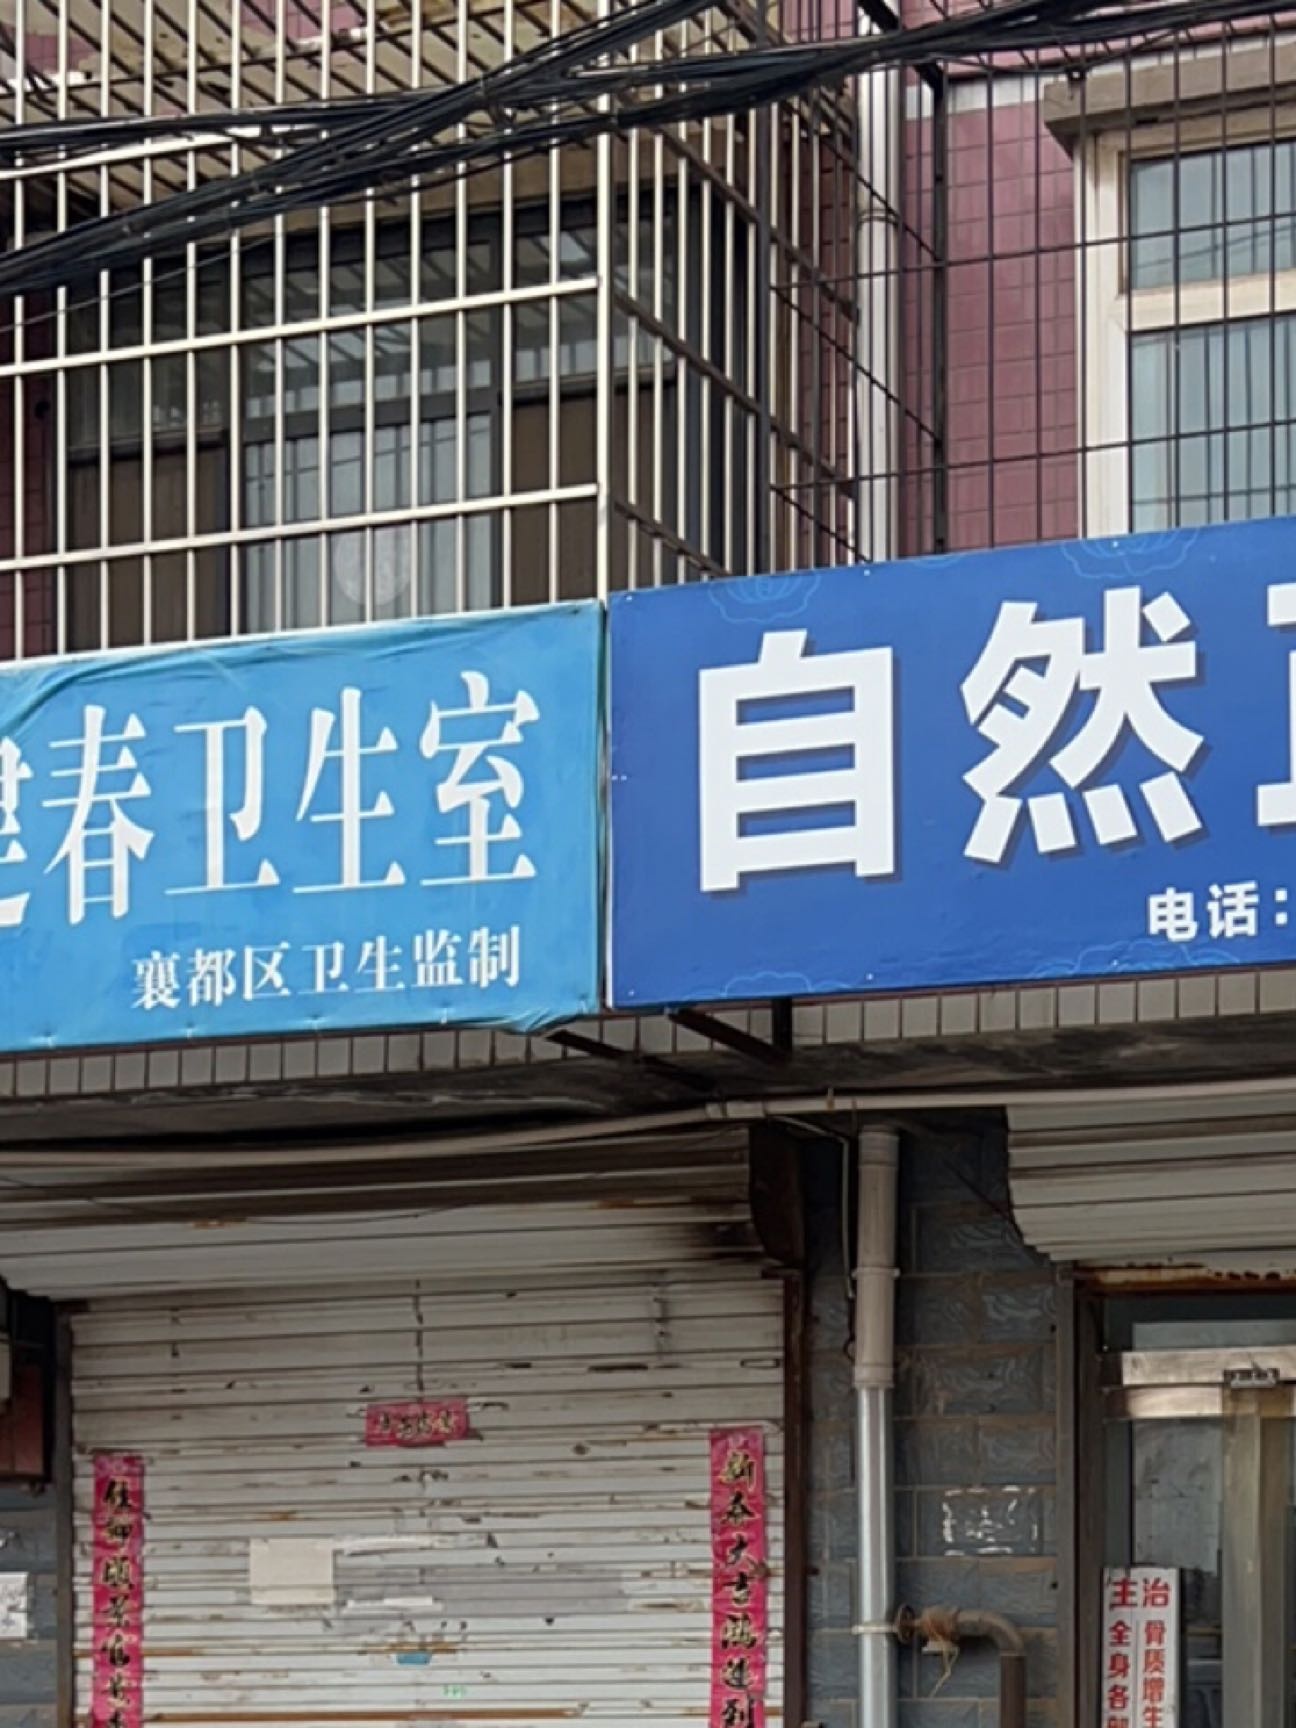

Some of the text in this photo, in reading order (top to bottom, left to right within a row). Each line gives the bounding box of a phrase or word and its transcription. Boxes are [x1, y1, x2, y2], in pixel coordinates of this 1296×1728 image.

[131, 926, 520, 1010] 襄都区卫生监制
